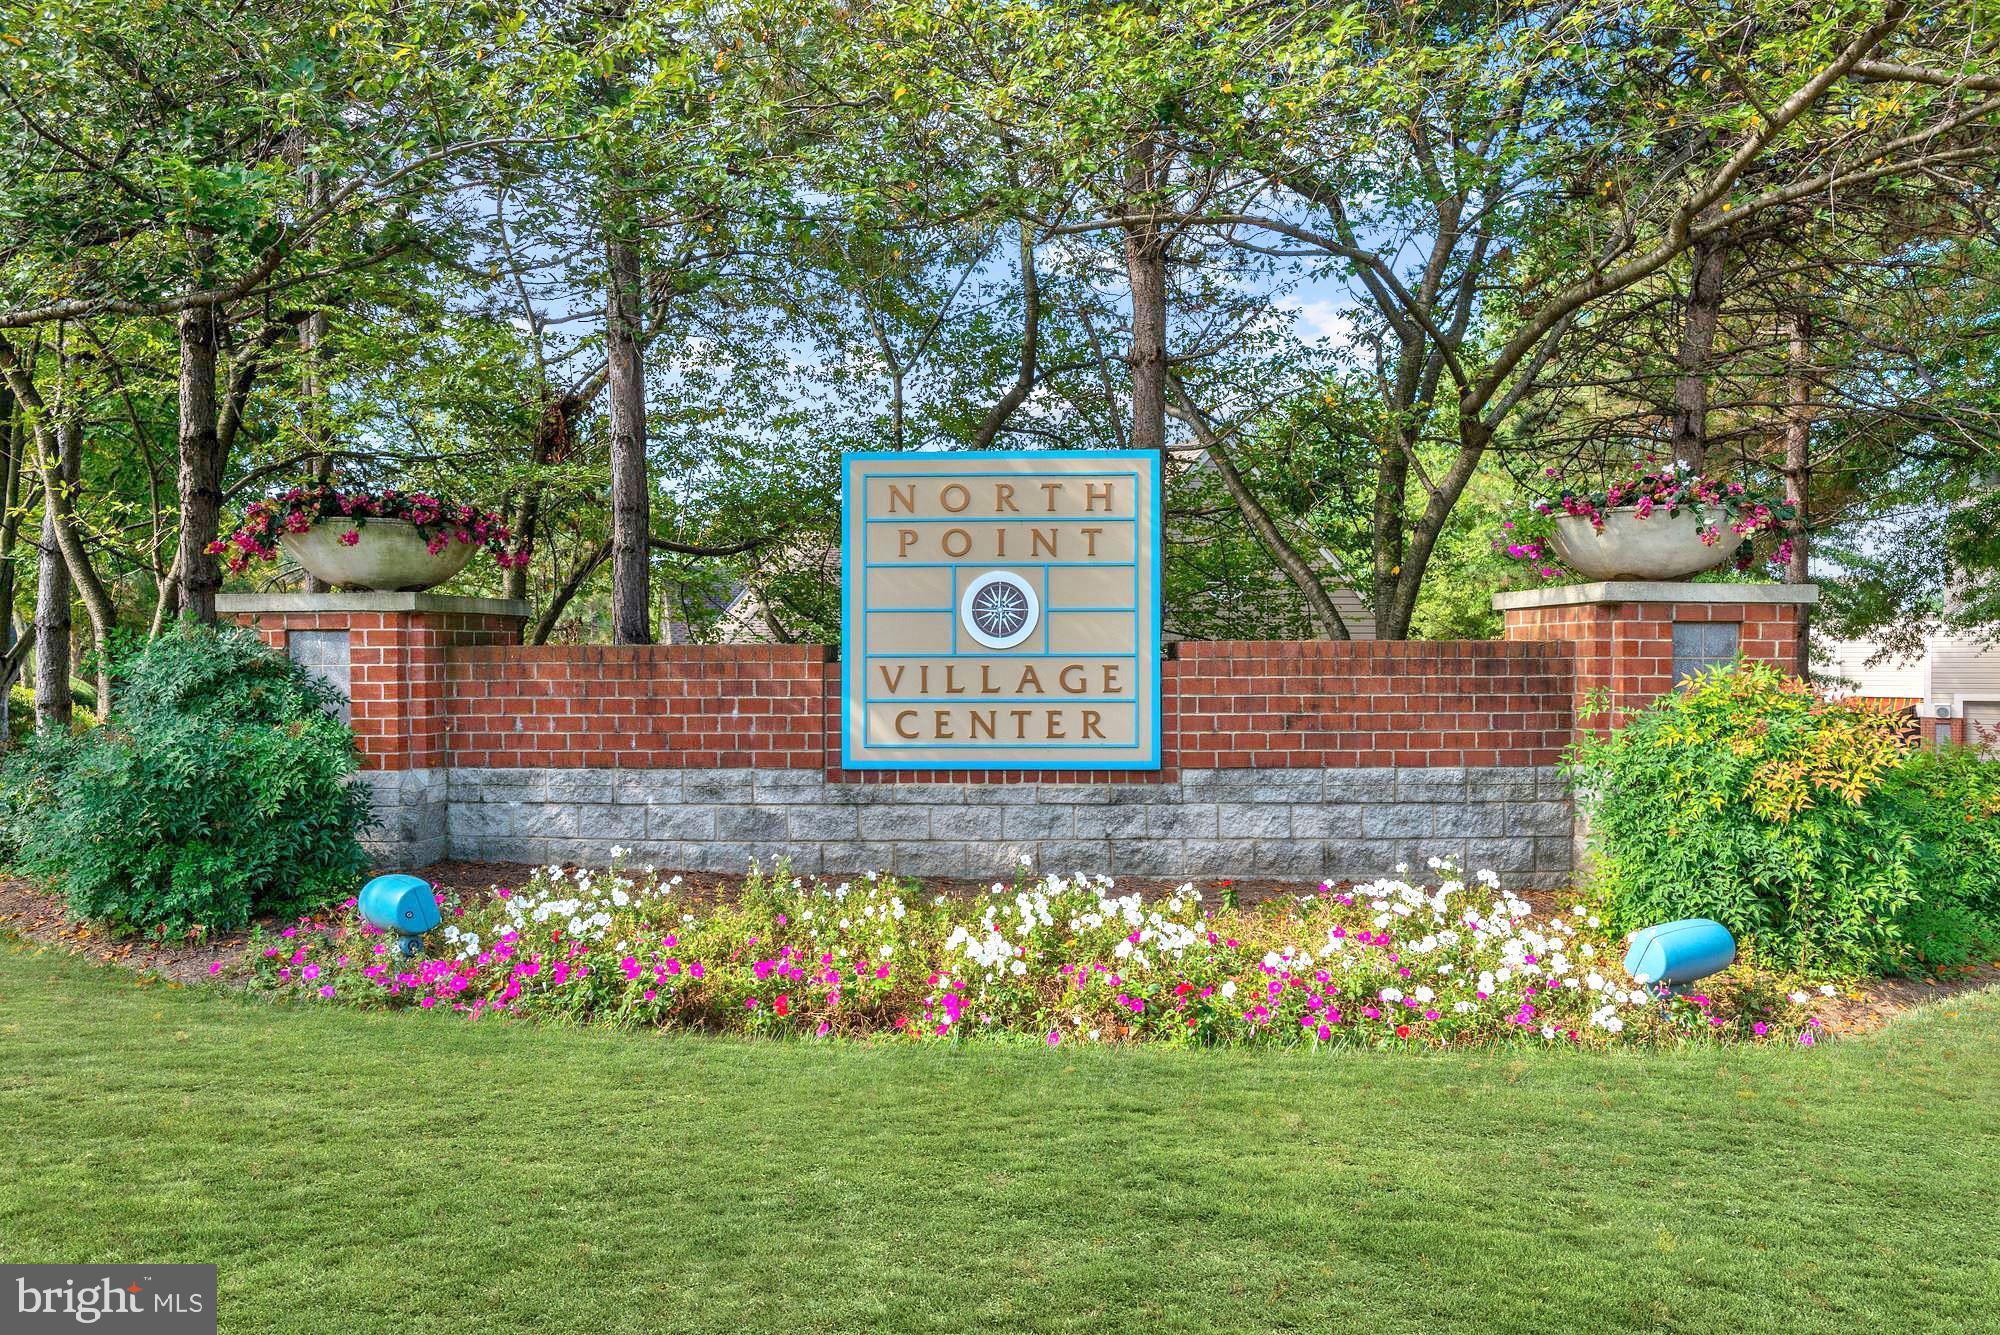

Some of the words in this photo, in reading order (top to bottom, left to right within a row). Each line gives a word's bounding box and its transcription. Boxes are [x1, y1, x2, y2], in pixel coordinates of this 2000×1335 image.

[888, 483, 1113, 513] NORTH
[897, 528, 1103, 558] POINT
[880, 664, 1123, 694] VILLAGE
[895, 710, 1106, 739] CENTER
